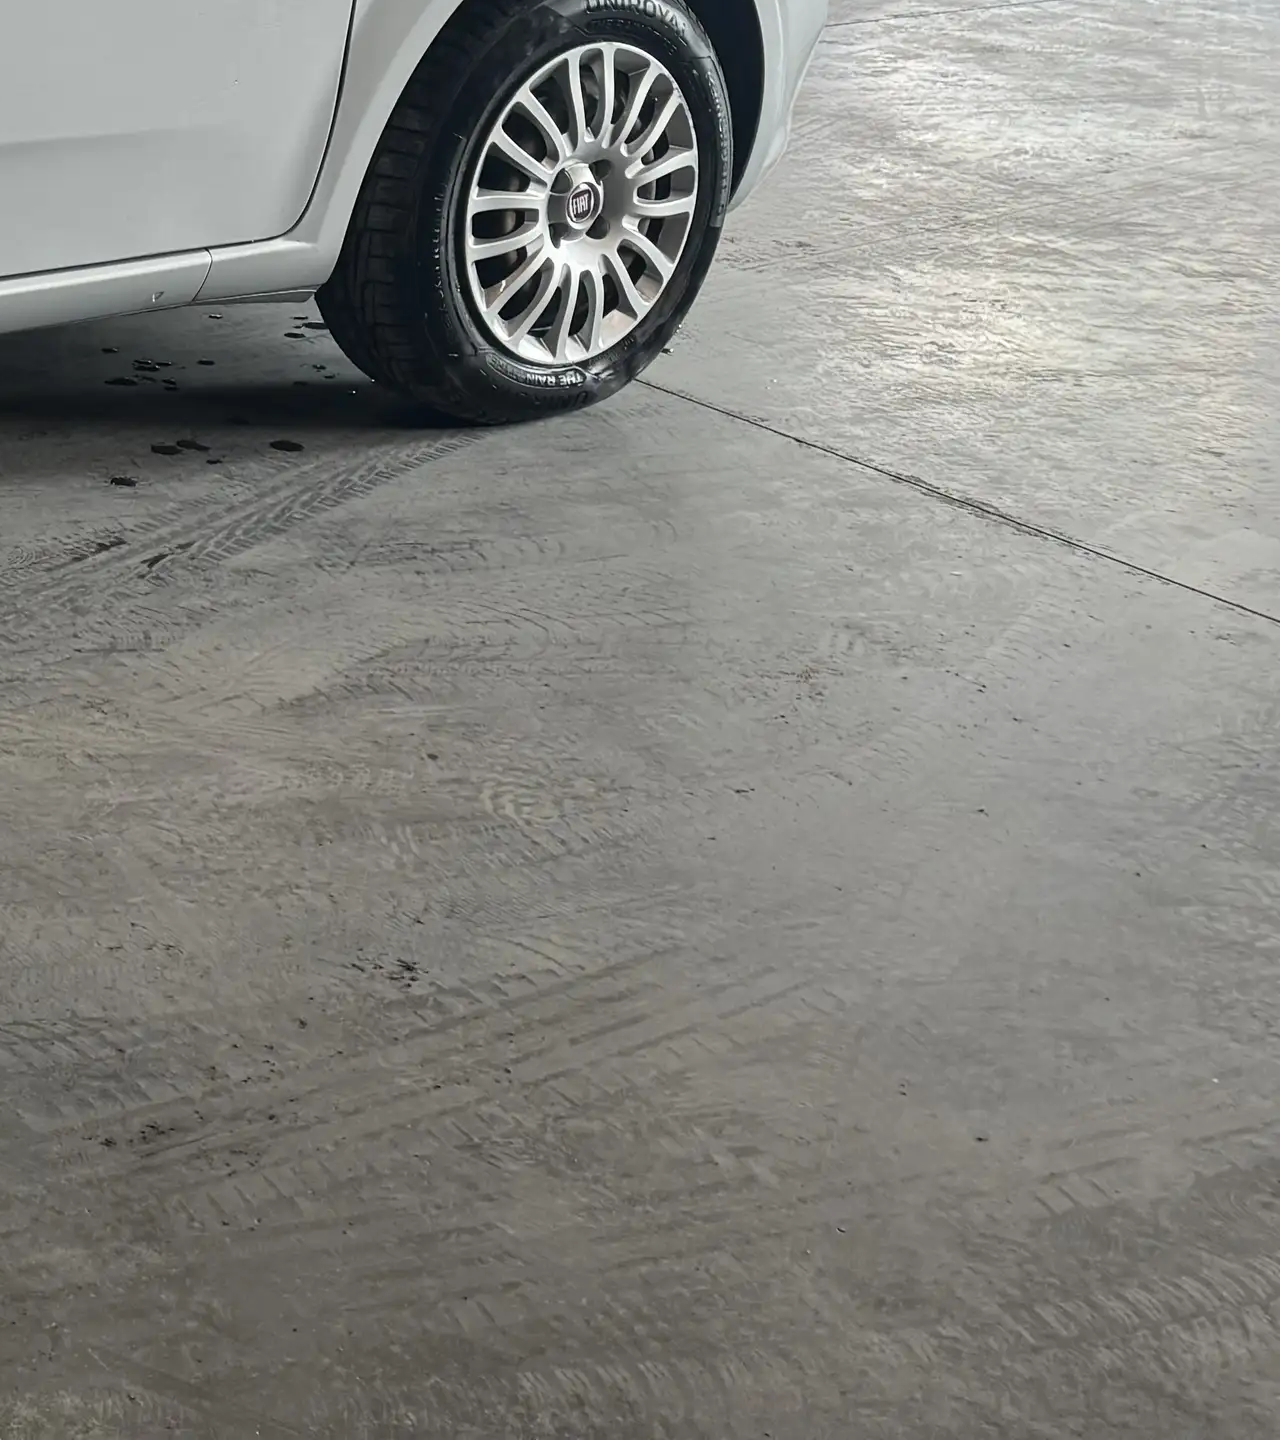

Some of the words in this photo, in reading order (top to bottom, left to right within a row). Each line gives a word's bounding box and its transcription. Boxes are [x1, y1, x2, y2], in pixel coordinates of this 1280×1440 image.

[572, 193, 589, 215] FIAT
[525, 372, 557, 388] RAIN
[558, 370, 584, 388] THE
